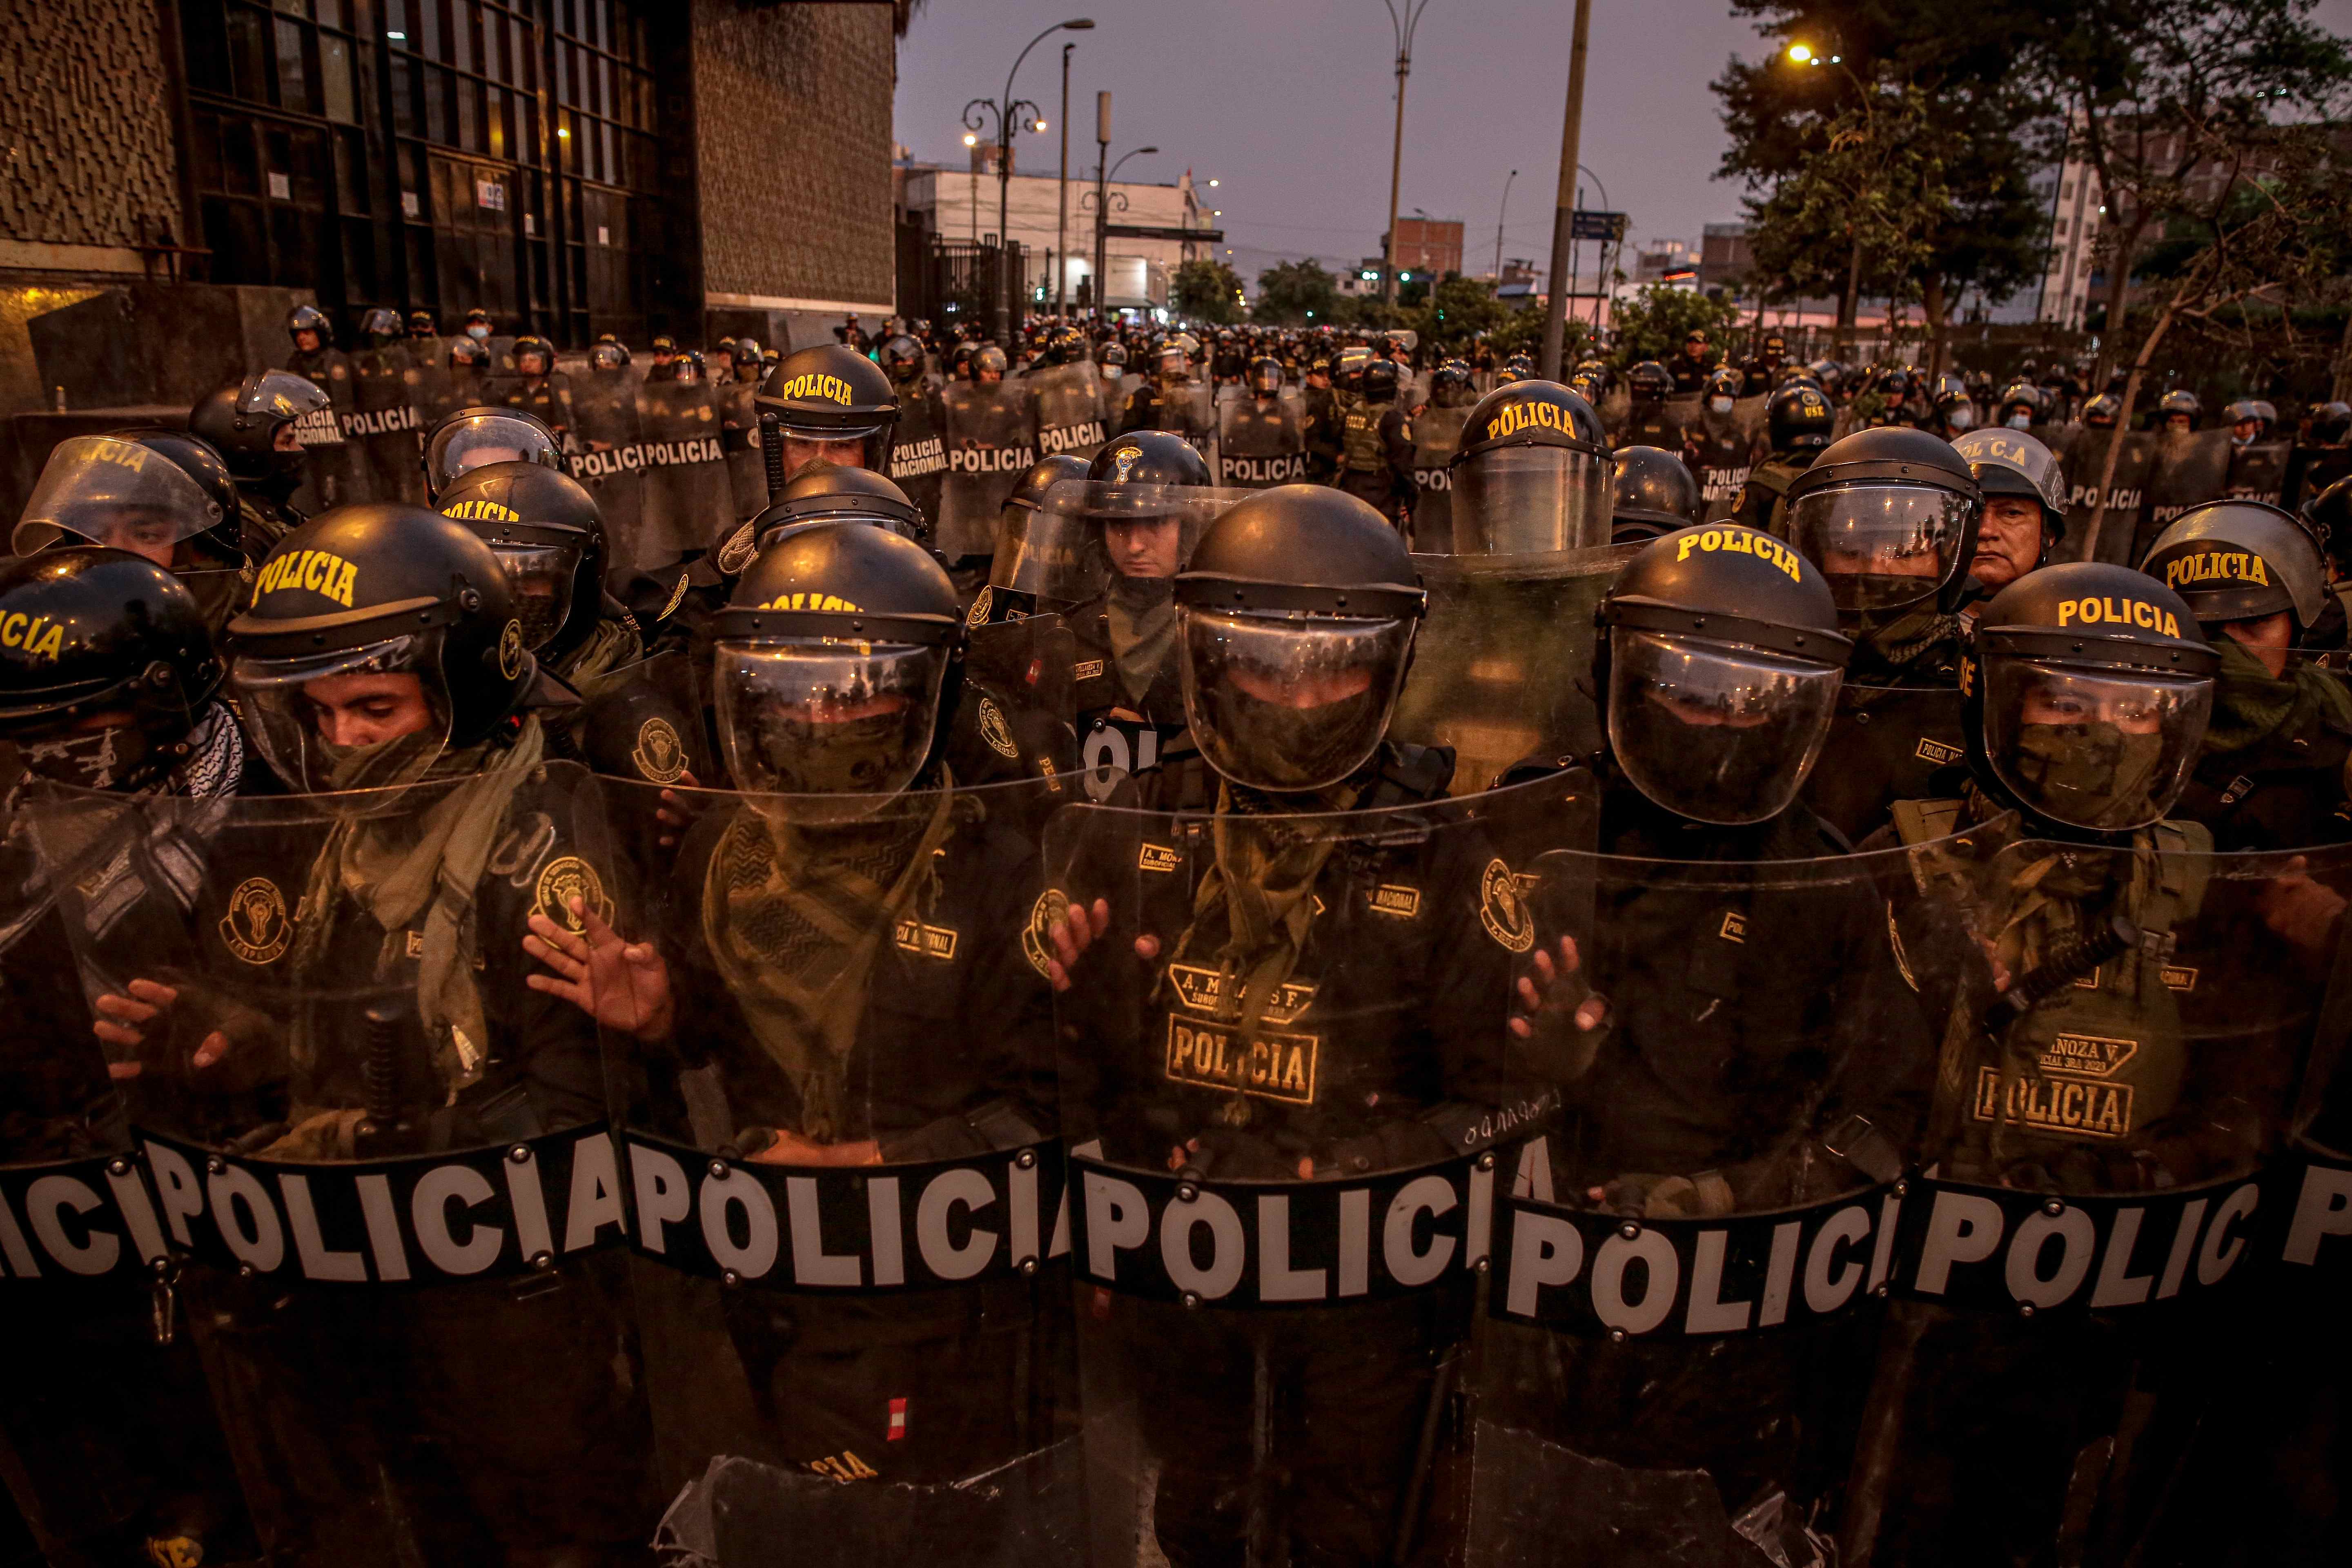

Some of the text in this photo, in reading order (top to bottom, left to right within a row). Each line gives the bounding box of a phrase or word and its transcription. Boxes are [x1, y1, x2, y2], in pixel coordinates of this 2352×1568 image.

[783, 374, 852, 406] POLICIA
[290, 408, 336, 428] OLICIA
[341, 405, 424, 436] POLICIA
[1487, 401, 1576, 439] POLICIA
[649, 438, 724, 466] POLICIA
[893, 437, 943, 462] POLICIA
[1039, 421, 1106, 454] POLICIA
[891, 451, 949, 478] NACIONAL
[950, 447, 1035, 472] POLICIA
[1223, 457, 1305, 481] POLICIA
[1676, 530, 1802, 583] POLICIA
[2167, 552, 2268, 590] POLICIA
[250, 550, 358, 608] POLICIA
[2058, 597, 2181, 638] POLICIA
[1922, 743, 1947, 760] POLICIA
[0, 1164, 169, 1278] ICI
[143, 1131, 628, 1281] POLICIA
[1506, 1163, 1938, 1334] POLICI
